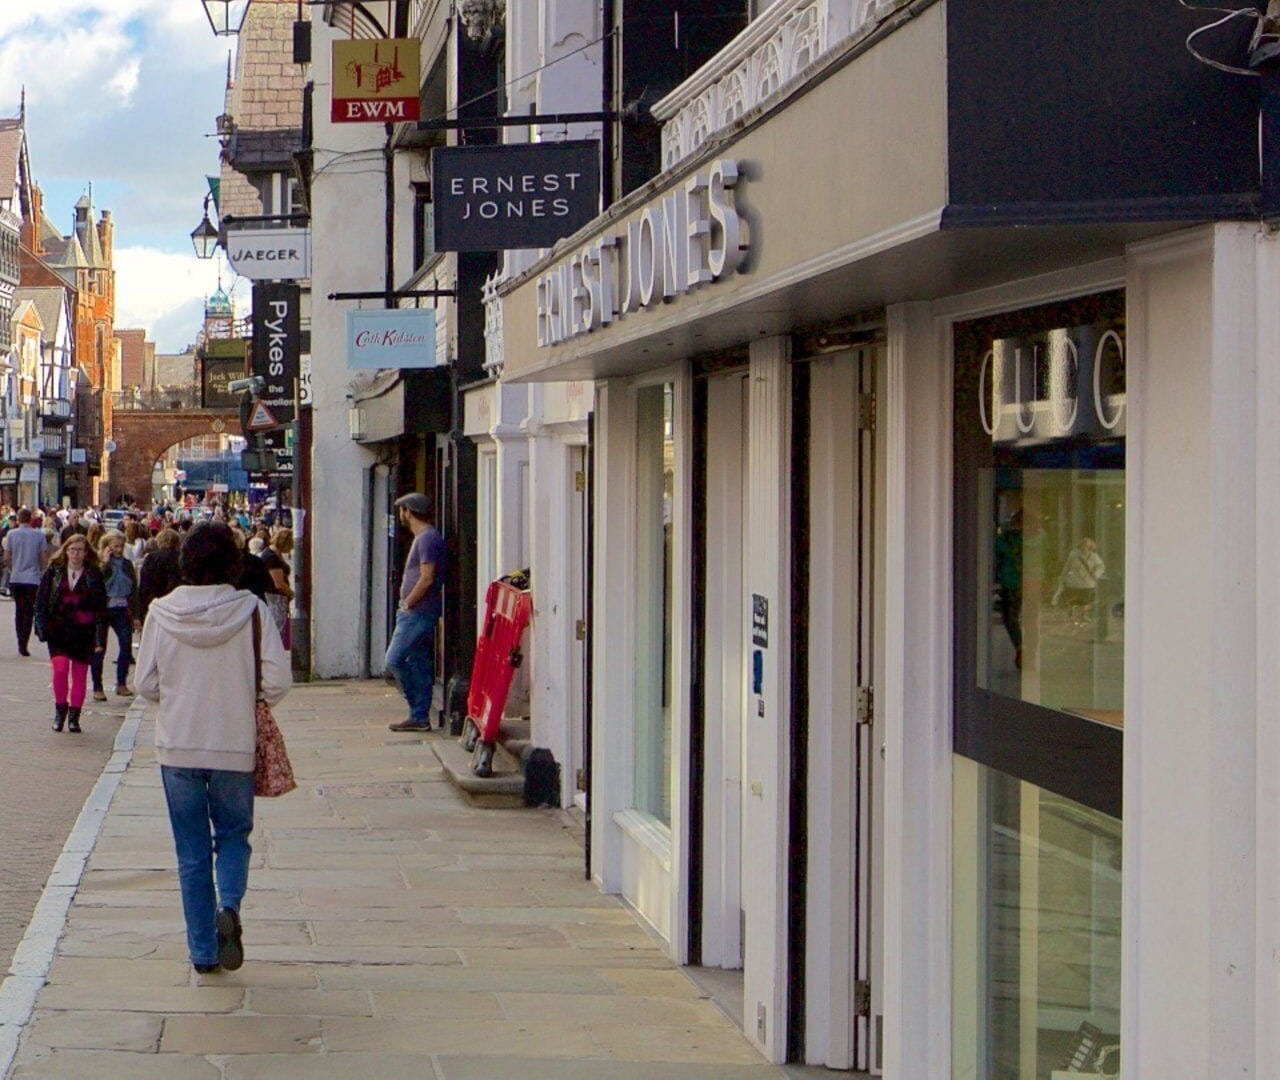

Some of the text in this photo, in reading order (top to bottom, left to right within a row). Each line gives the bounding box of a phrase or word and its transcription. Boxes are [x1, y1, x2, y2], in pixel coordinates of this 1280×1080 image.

[346, 100, 405, 119] EWM
[451, 173, 581, 196] ERNEST
[463, 198, 570, 220] JONES
[232, 248, 300, 262] JAEGER
[536, 159, 740, 348] ERNEST JONES
[264, 300, 288, 377] Pykes
[210, 372, 227, 383] Jack
[268, 385, 284, 394] the
